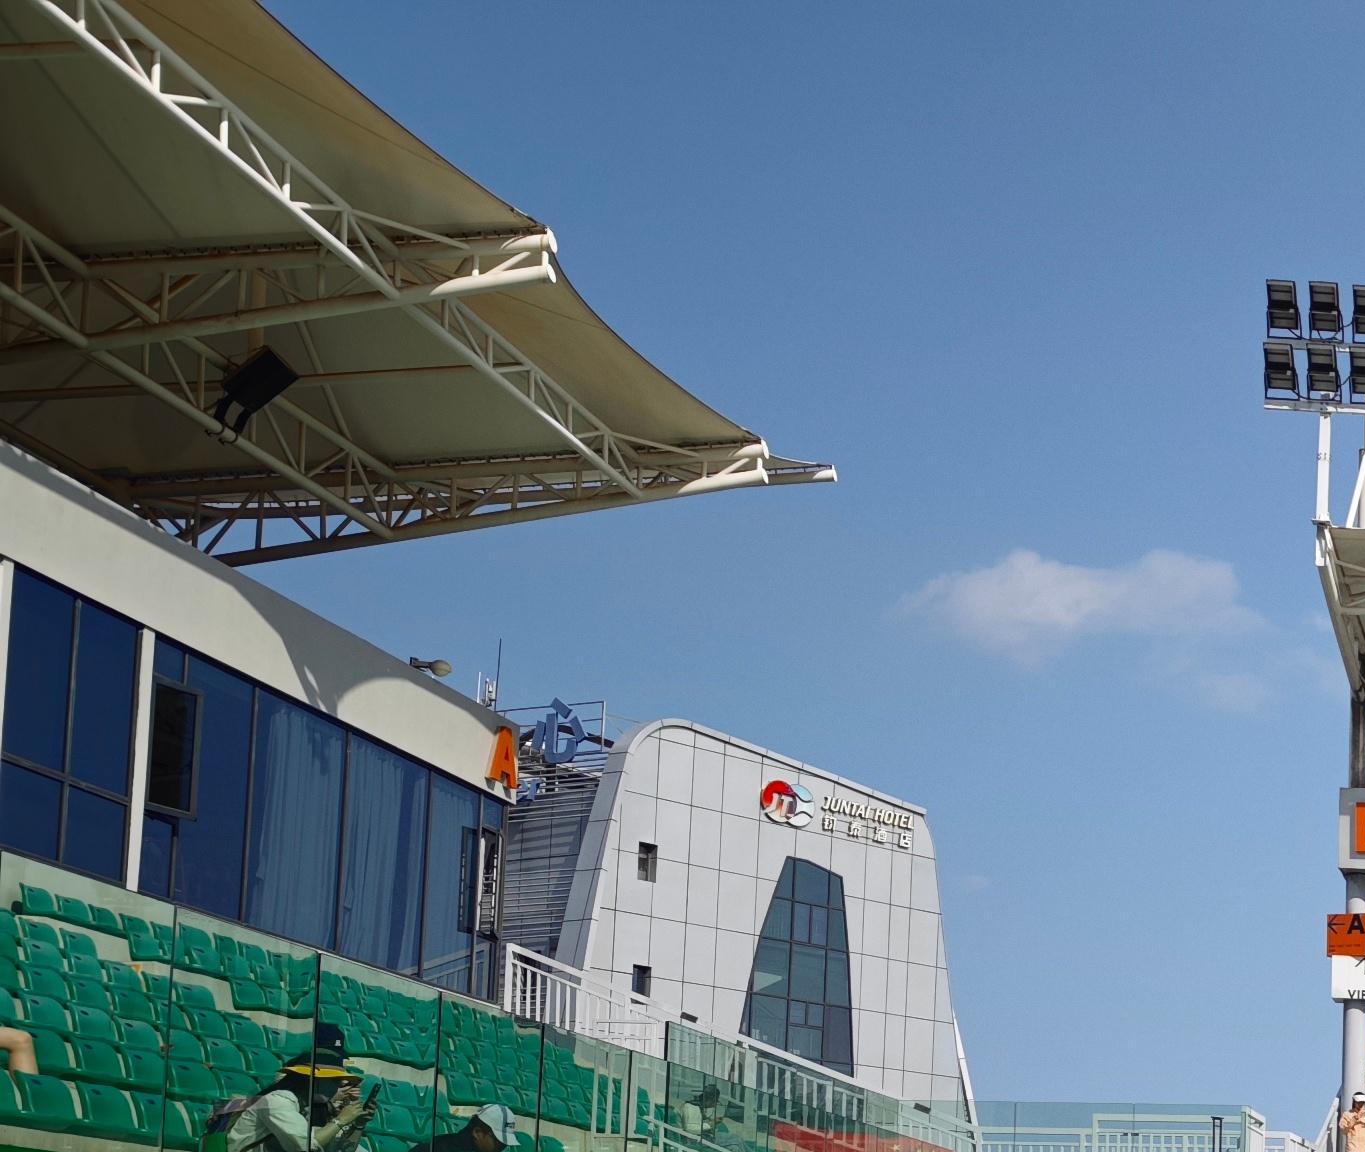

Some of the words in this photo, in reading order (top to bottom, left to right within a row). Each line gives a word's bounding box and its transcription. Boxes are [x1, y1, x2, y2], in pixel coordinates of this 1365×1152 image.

[489, 726, 518, 789] A
[821, 795, 871, 821] JUNTAI
[874, 807, 915, 830] HOTEL
[1347, 914, 1365, 934] A
